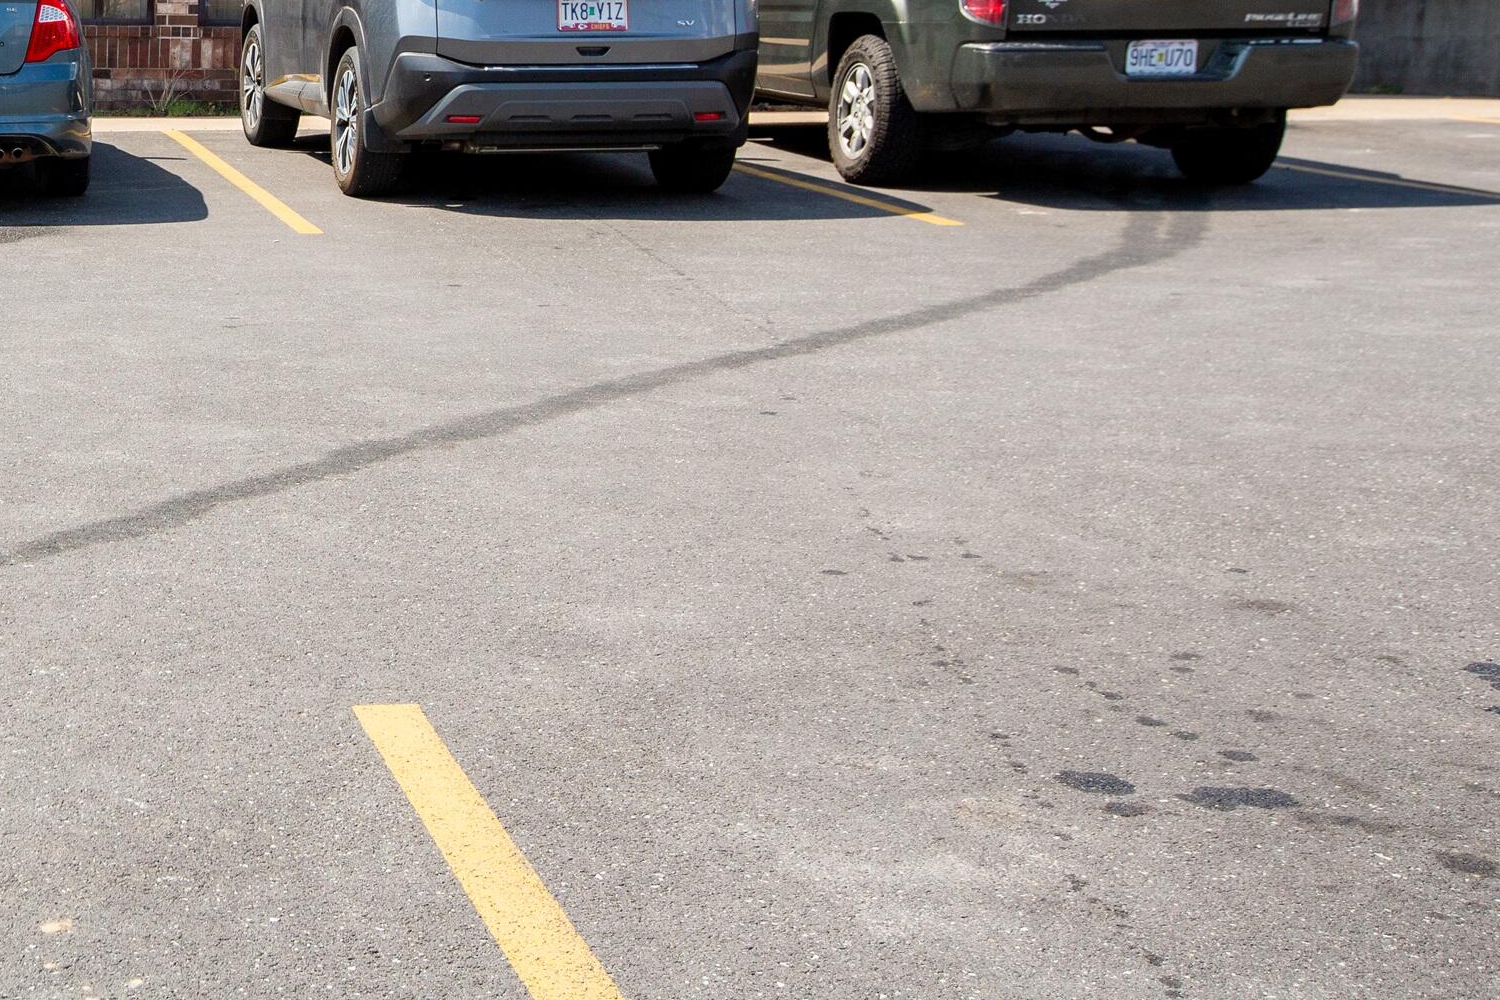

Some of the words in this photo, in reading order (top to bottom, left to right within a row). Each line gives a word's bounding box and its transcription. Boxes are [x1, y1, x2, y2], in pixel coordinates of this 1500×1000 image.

[561, 2, 589, 21] TK8
[596, 2, 624, 21] Y1Z
[1130, 48, 1158, 67] 9HE
